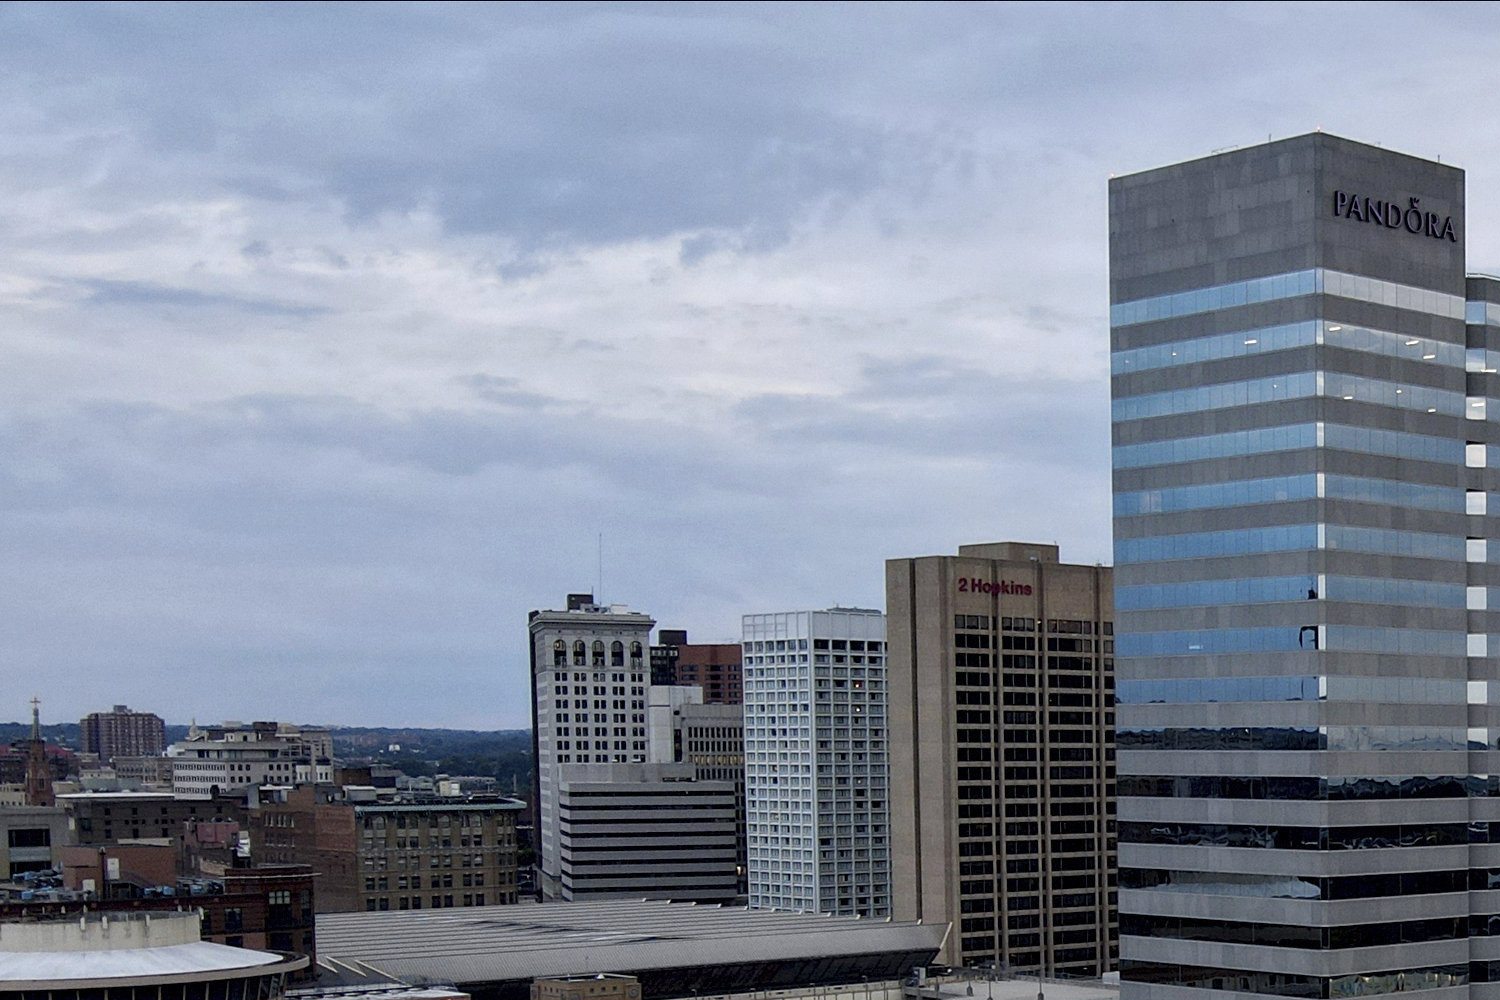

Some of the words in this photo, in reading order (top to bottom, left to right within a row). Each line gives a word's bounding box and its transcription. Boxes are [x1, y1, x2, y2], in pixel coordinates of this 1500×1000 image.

[1334, 190, 1457, 242] PANDORA
[958, 577, 968, 593] 2
[971, 578, 1033, 596] Hopkins
